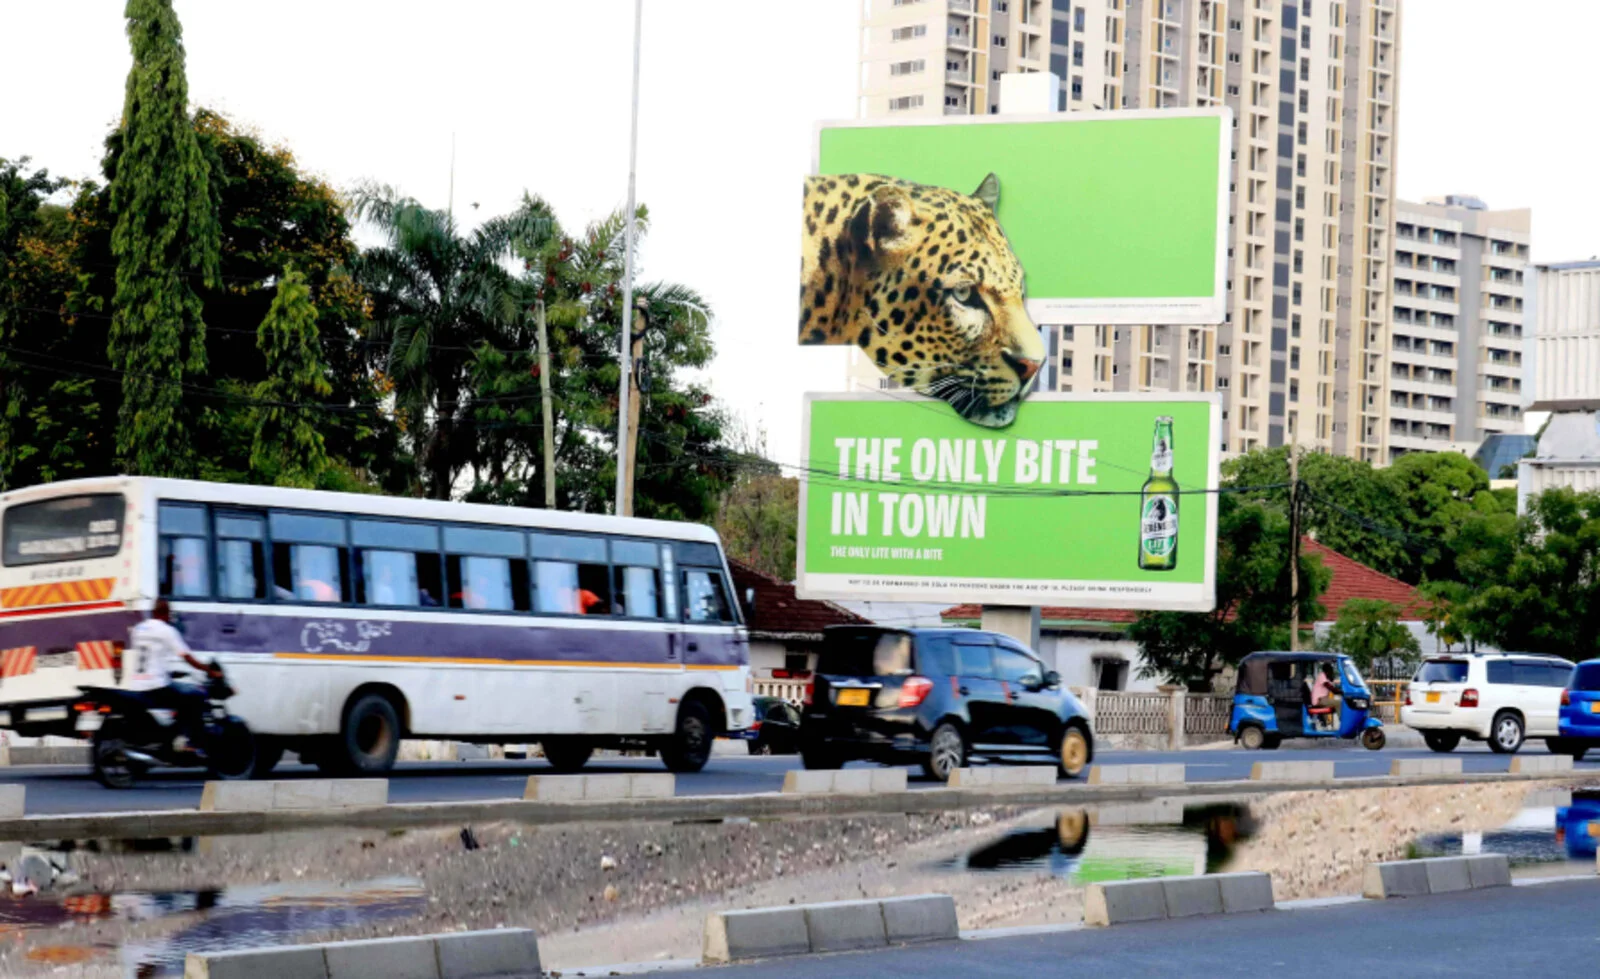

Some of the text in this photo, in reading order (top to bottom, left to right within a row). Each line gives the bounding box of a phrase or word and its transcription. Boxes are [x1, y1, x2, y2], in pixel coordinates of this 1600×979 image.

[835, 437, 1098, 484] THE ONLY BITE
[831, 491, 987, 539] IN TOWN
[830, 546, 943, 560] THE ONLY LITE WITH A BITE
